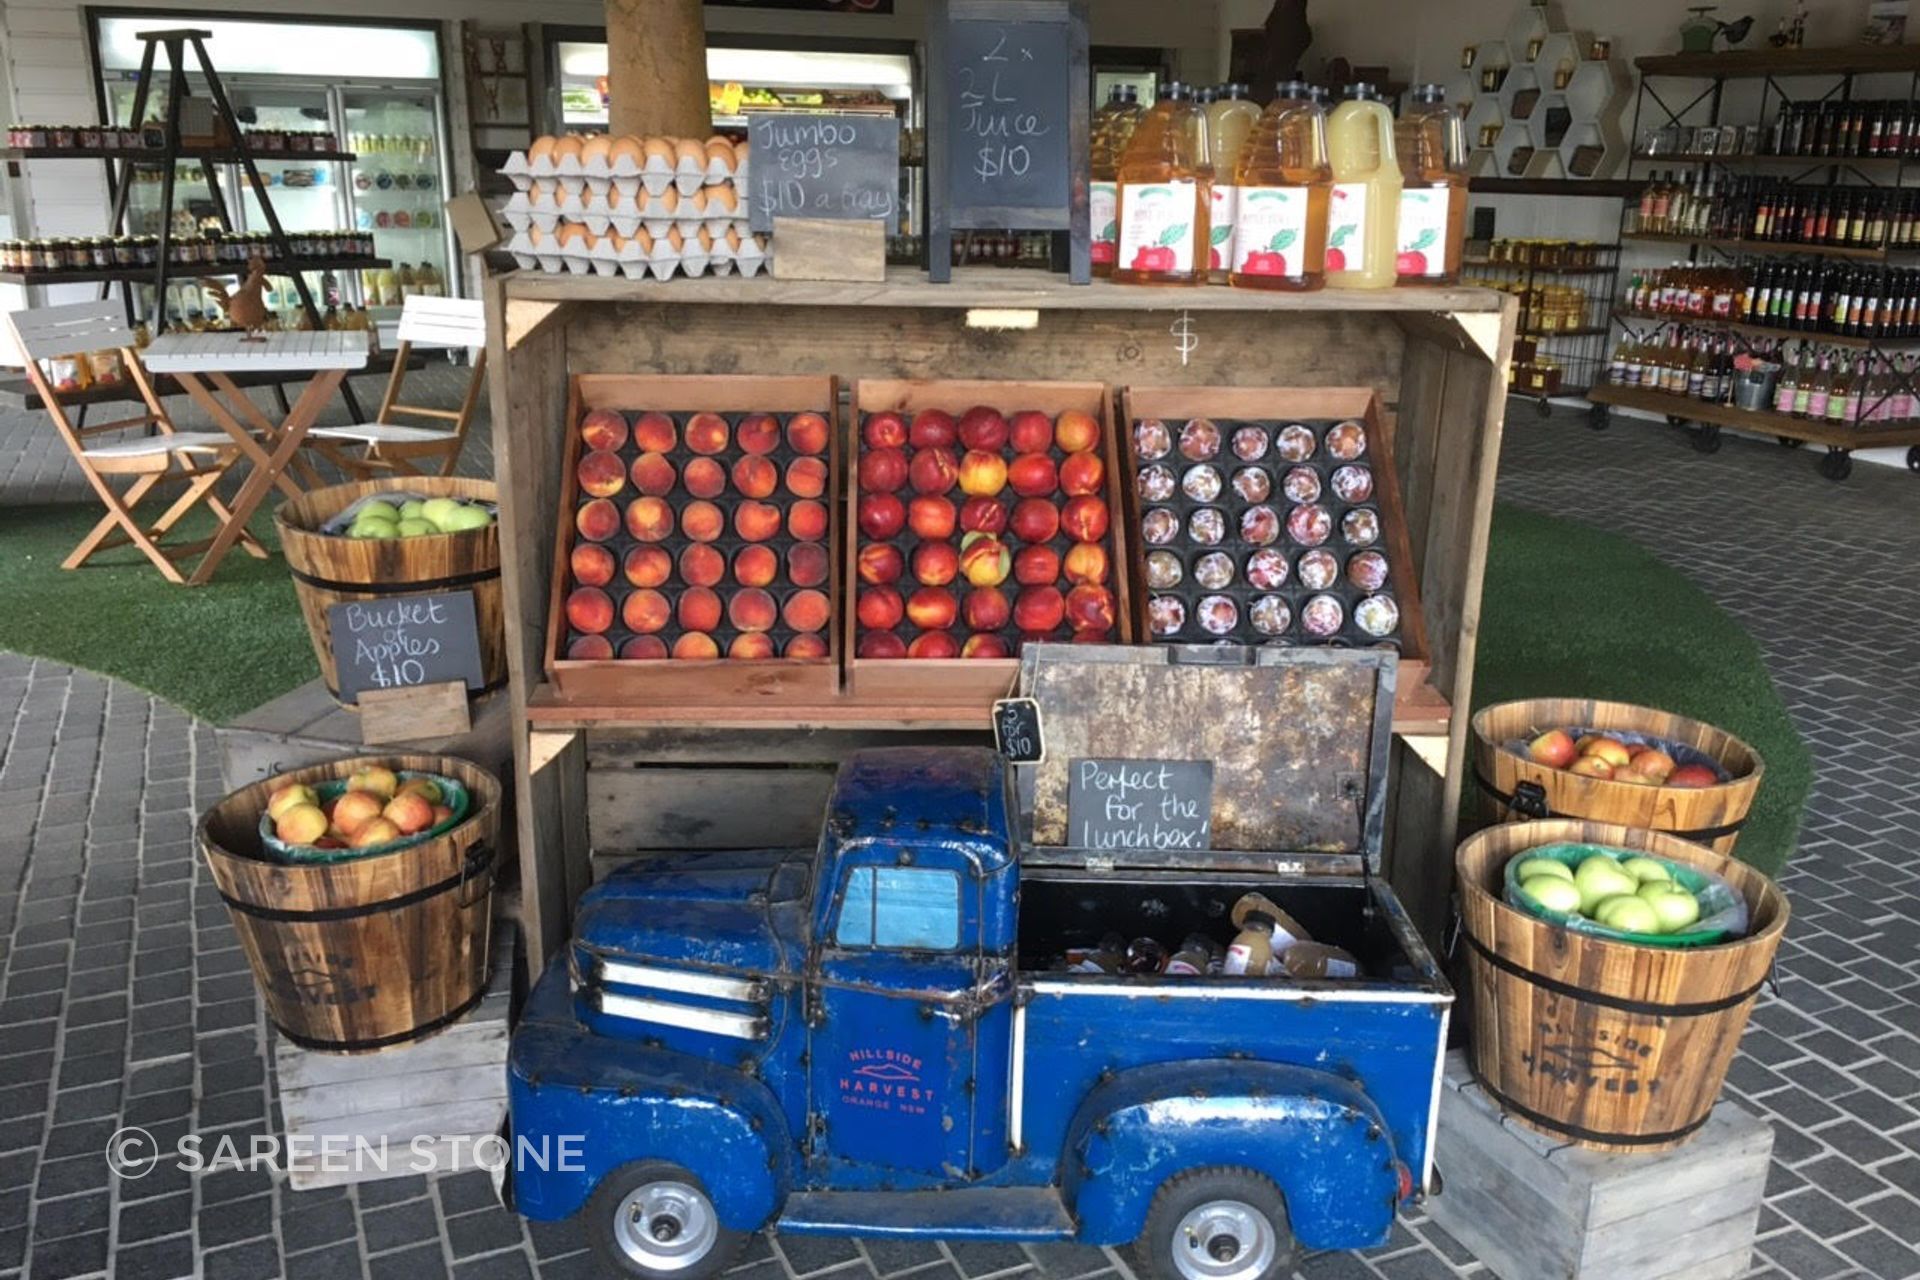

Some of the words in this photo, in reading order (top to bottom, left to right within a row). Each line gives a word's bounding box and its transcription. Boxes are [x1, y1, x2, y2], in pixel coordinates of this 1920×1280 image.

[982, 28, 1008, 61] 2
[961, 101, 1050, 137] Juice
[758, 120, 856, 149] Jumbo
[974, 140, 1030, 184] $10
[758, 177, 805, 216] $10
[815, 191, 831, 209] a
[841, 182, 892, 218] tray
[346, 598, 448, 632] Bucket
[355, 635, 440, 664] Apples
[383, 628, 407, 643] of
[370, 659, 425, 687] $10
[1005, 737, 1031, 758] $10
[1081, 761, 1174, 798] Perfect
[1105, 794, 1144, 821] for
[1161, 793, 1200, 821] the
[849, 1048, 922, 1070] HILLSIDE
[840, 1078, 935, 1102] HARVEST
[842, 1095, 890, 1110] ORANGE
